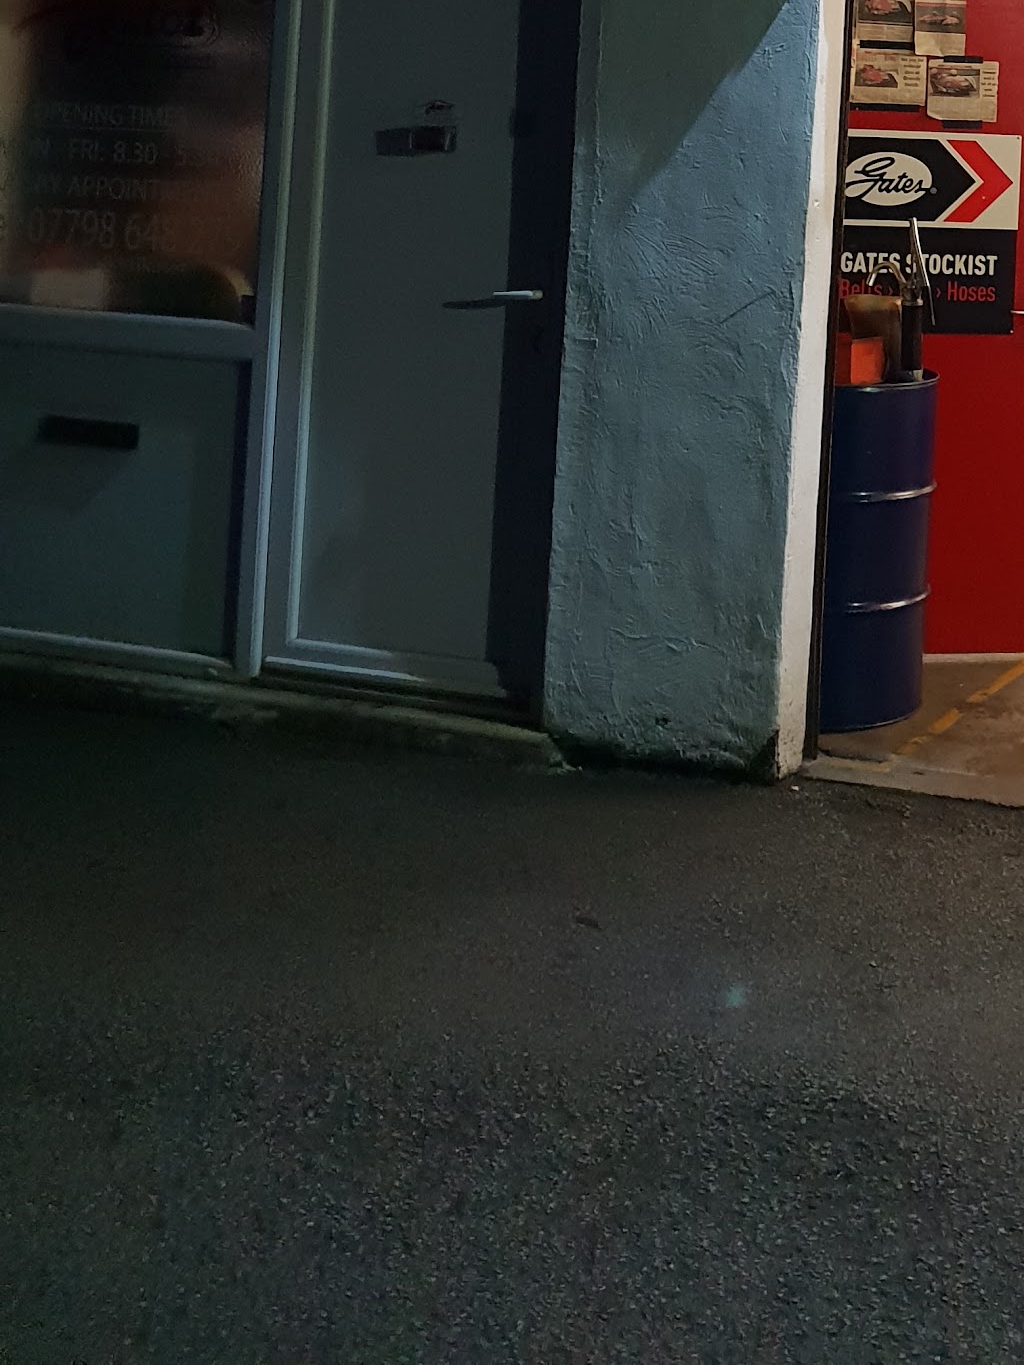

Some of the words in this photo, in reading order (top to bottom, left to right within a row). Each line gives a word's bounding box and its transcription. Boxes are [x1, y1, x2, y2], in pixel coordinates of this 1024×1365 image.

[846, 156, 931, 197] Gates
[840, 251, 901, 274] GATES
[905, 253, 998, 276] STOCKIST
[947, 281, 996, 302] Hoses
